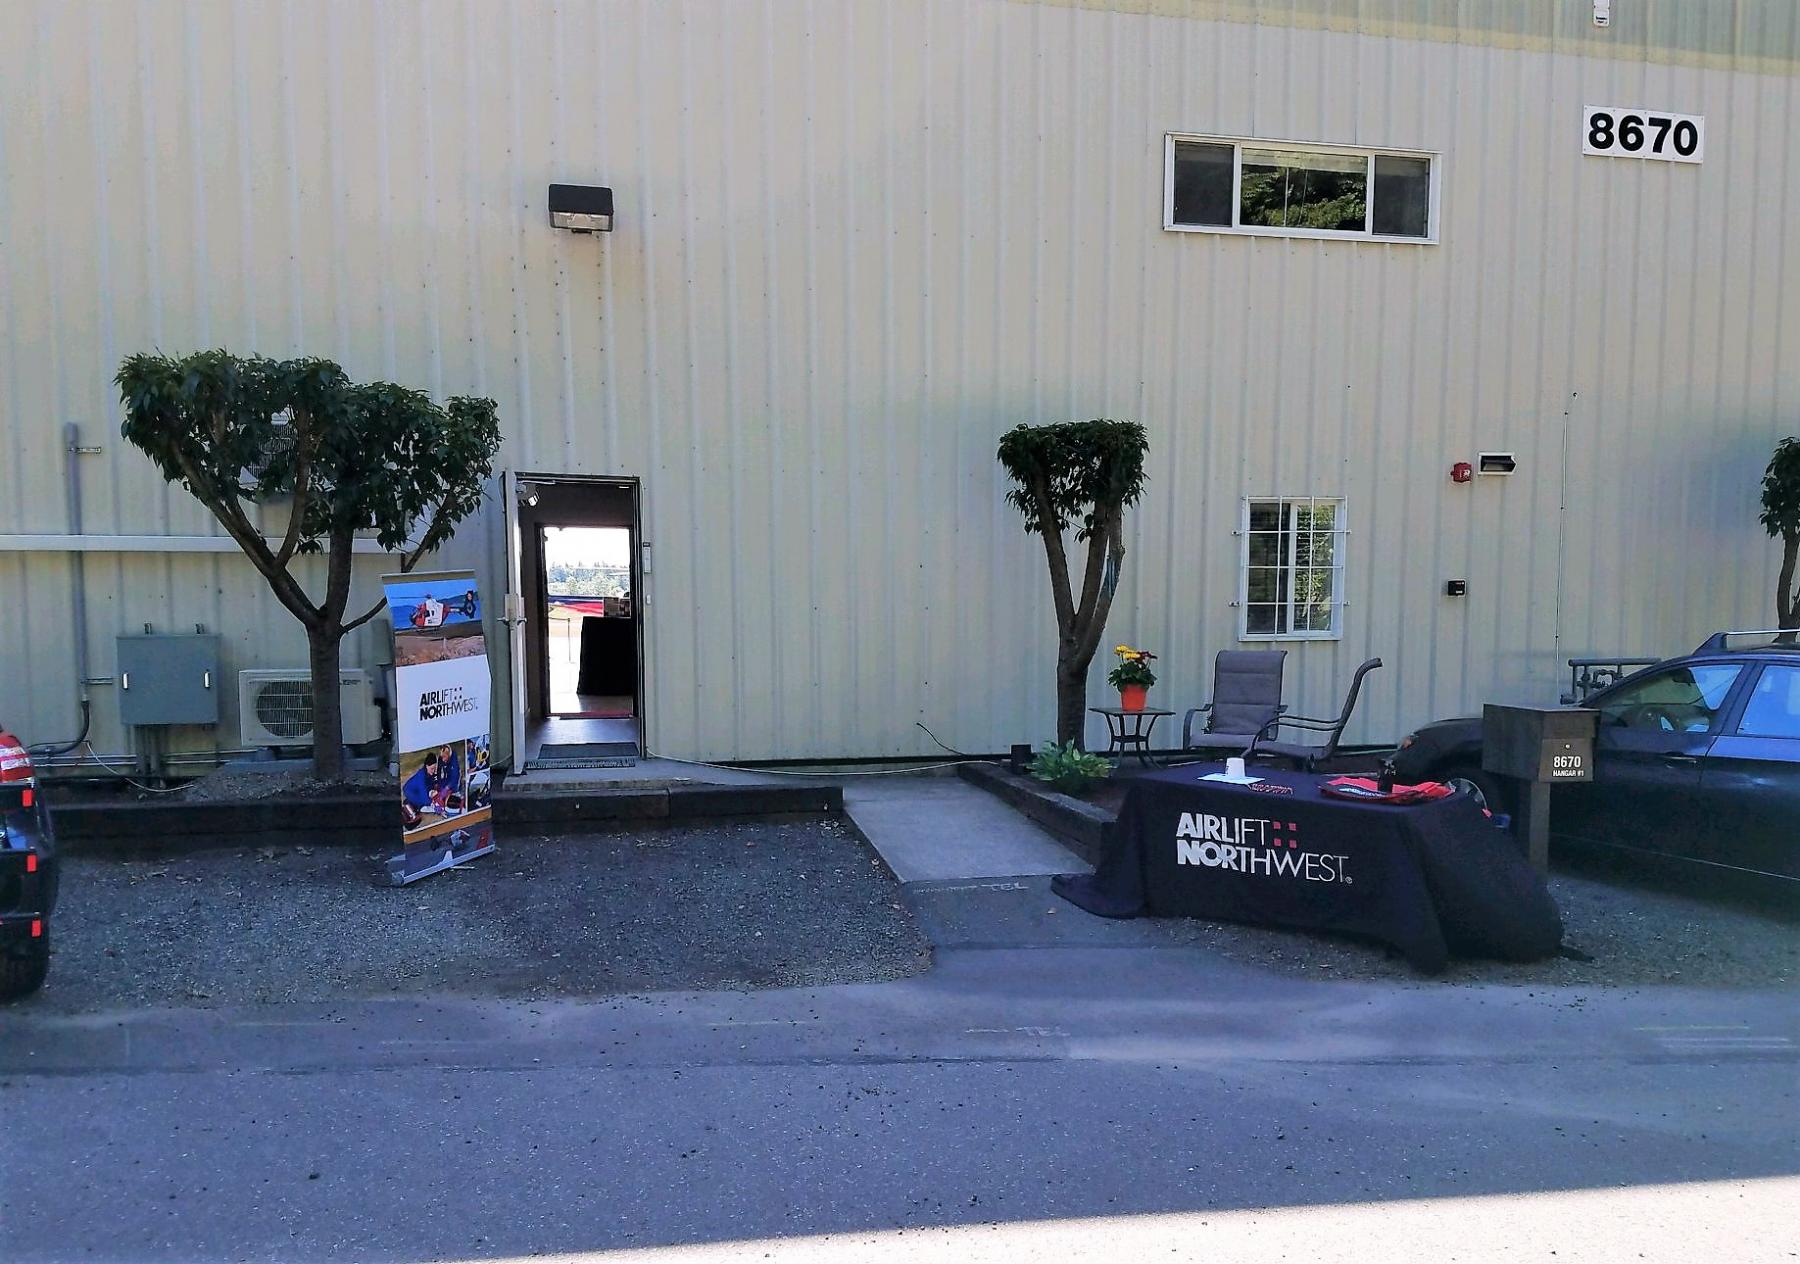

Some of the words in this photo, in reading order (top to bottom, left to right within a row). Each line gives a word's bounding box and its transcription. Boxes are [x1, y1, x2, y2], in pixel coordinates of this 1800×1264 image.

[1588, 112, 1698, 157] 8670
[420, 688, 454, 707] AIRLIFT
[420, 697, 477, 720] NORTHWEST
[1553, 756, 1581, 768] 8670
[1176, 812, 1270, 846] AIRLIFT
[1176, 839, 1350, 884] NORTHWEST
